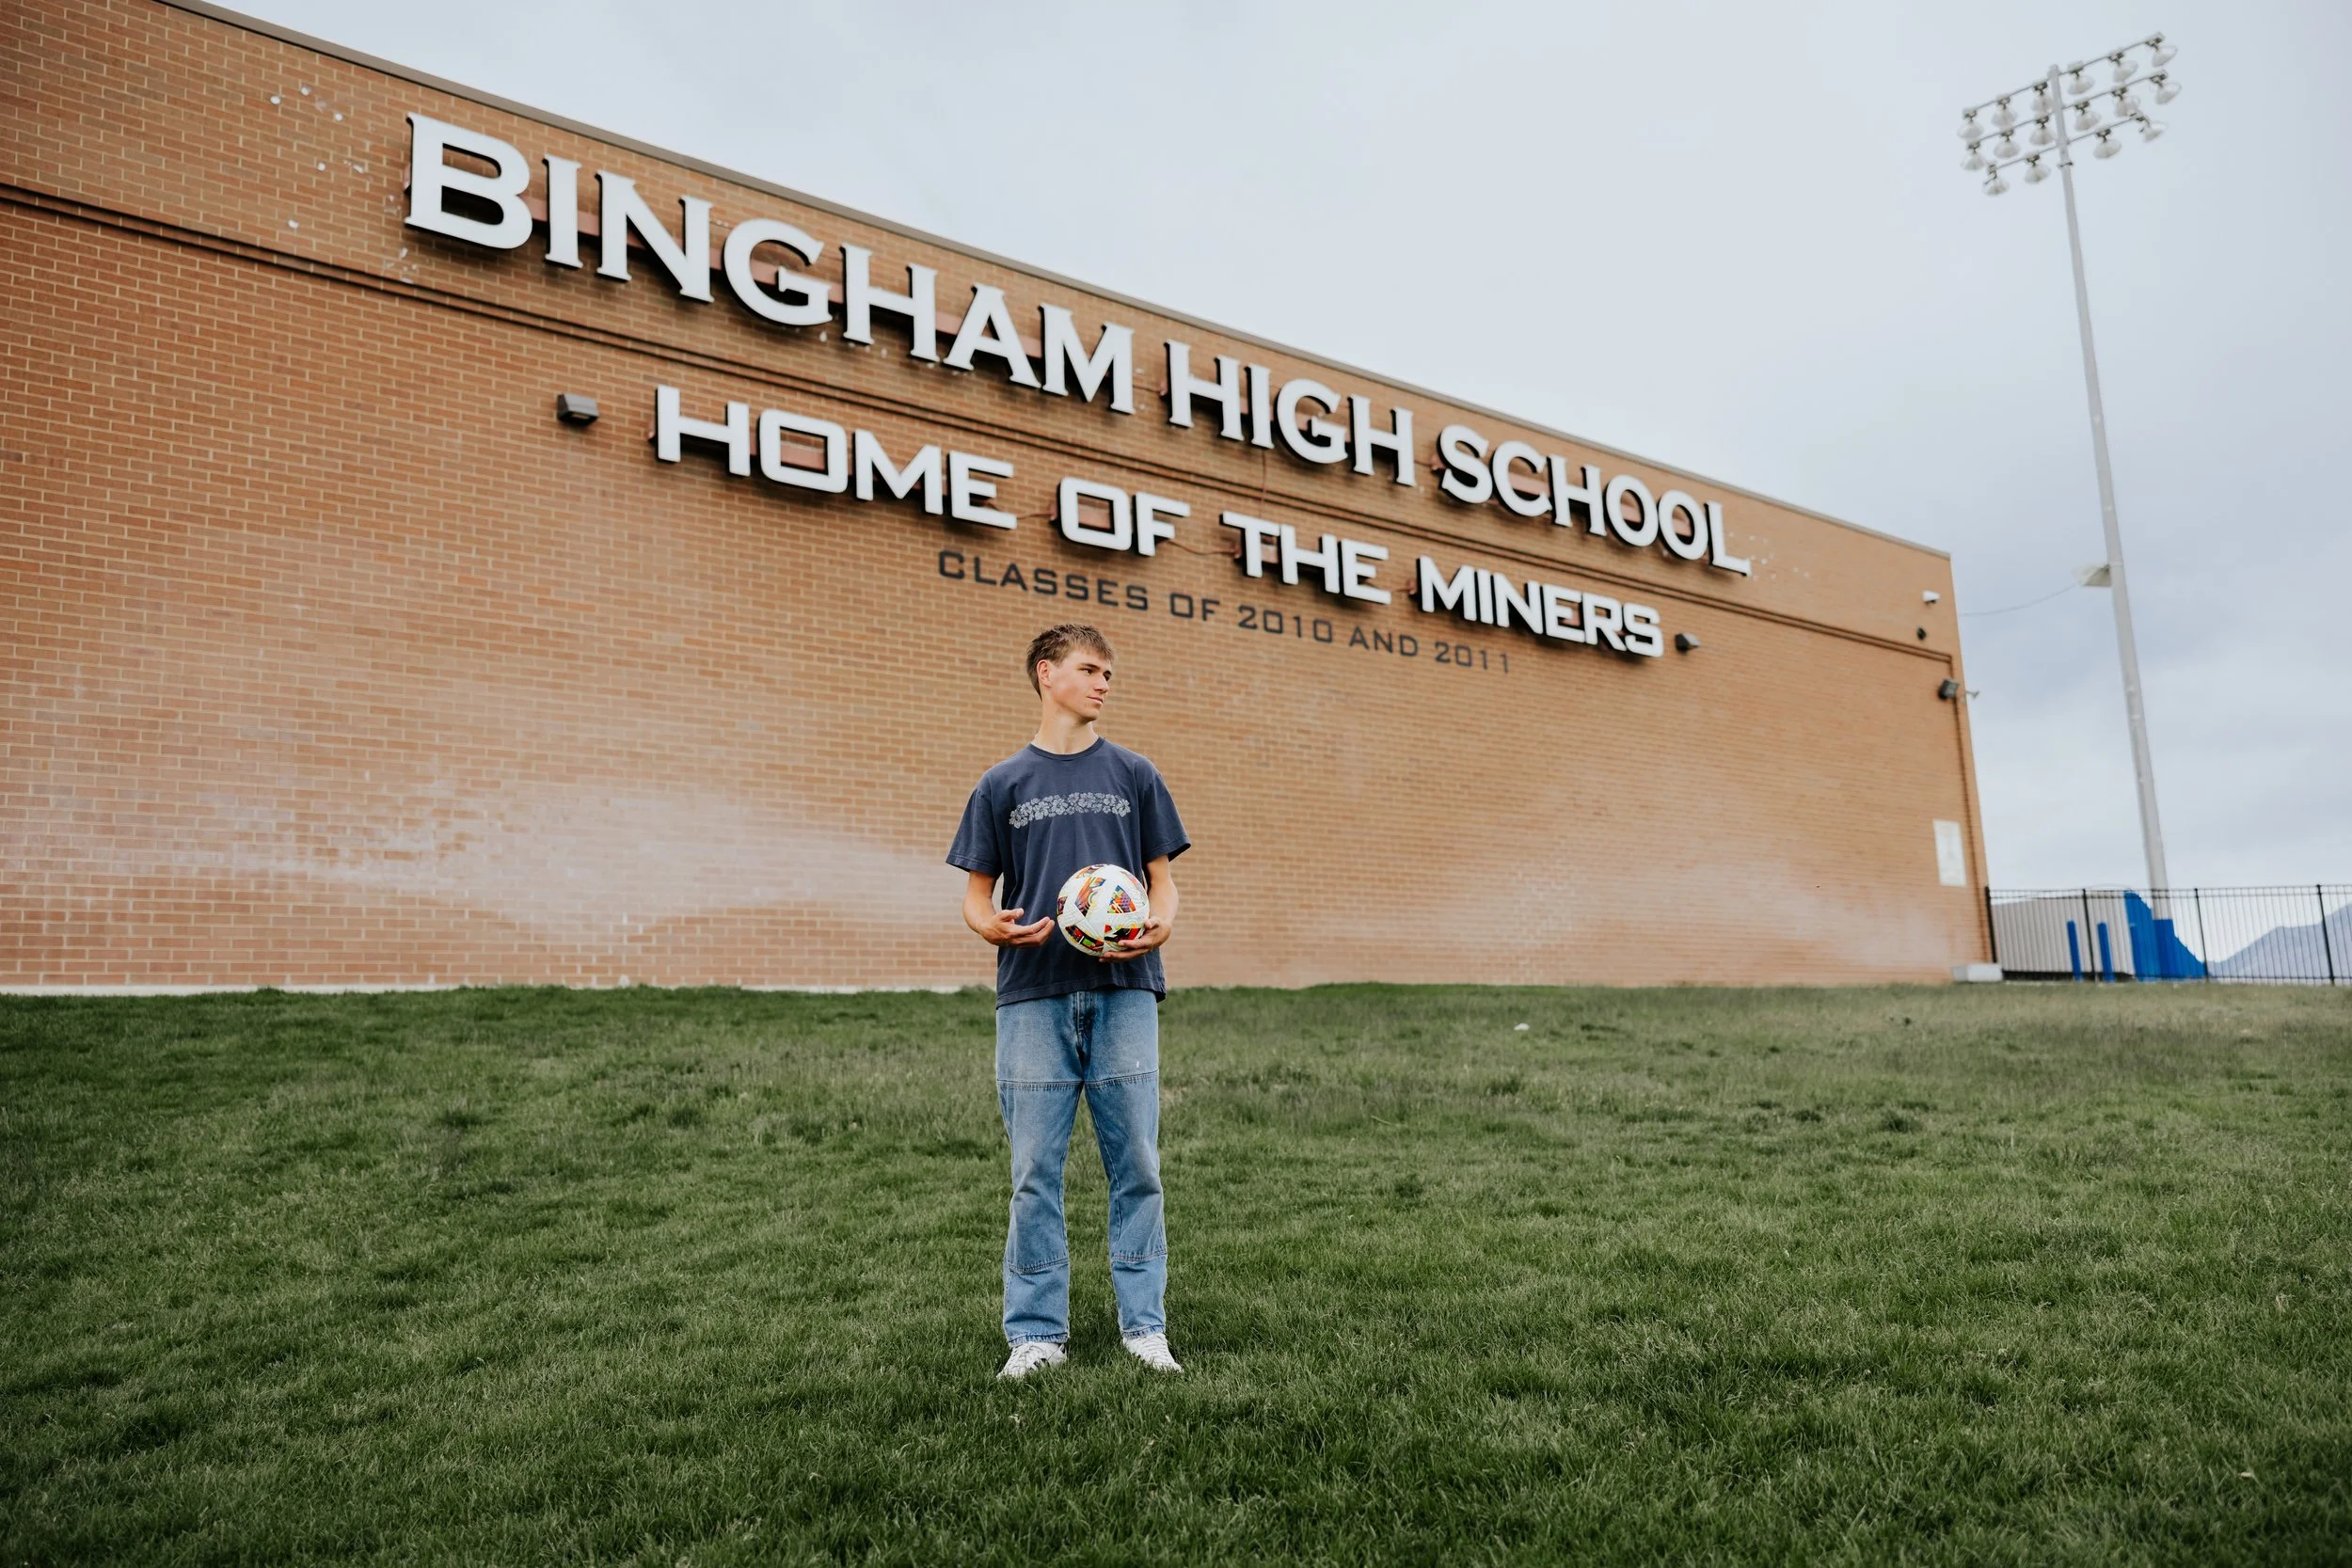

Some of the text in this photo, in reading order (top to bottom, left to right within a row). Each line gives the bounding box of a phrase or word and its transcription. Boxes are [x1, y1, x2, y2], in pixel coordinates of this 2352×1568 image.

[405, 112, 1751, 577] BINGHAM HIGH SCHOOL
[656, 384, 1664, 657] HOME OF THE MINERS
[938, 549, 1509, 673] CLASSES OF 2010 AND 2011
